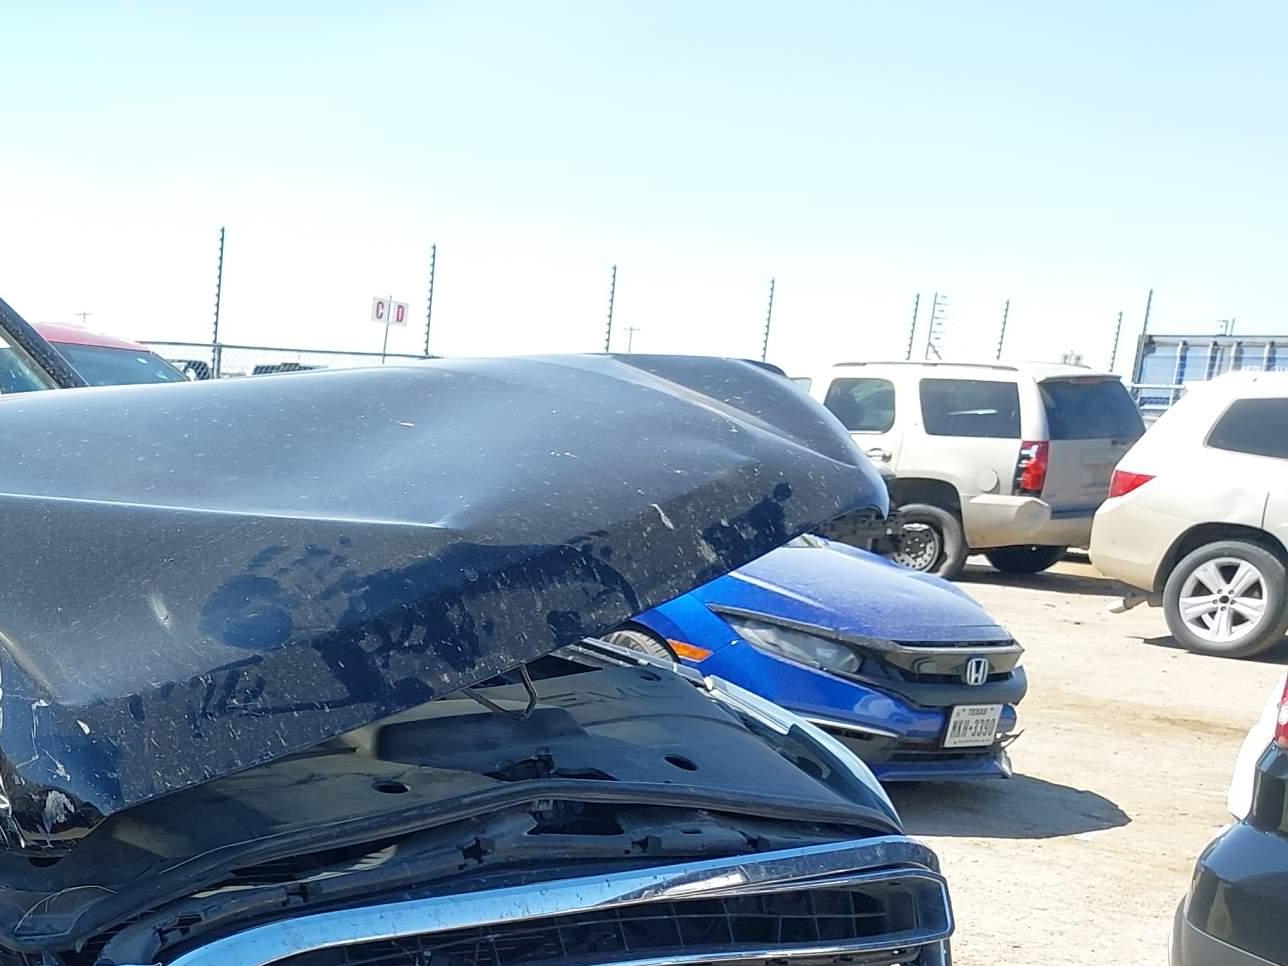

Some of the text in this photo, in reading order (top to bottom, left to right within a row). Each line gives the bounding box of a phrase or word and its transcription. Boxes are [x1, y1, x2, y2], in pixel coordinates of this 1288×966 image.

[376, 301, 405, 322] C D
[968, 708, 988, 716] TEXAS
